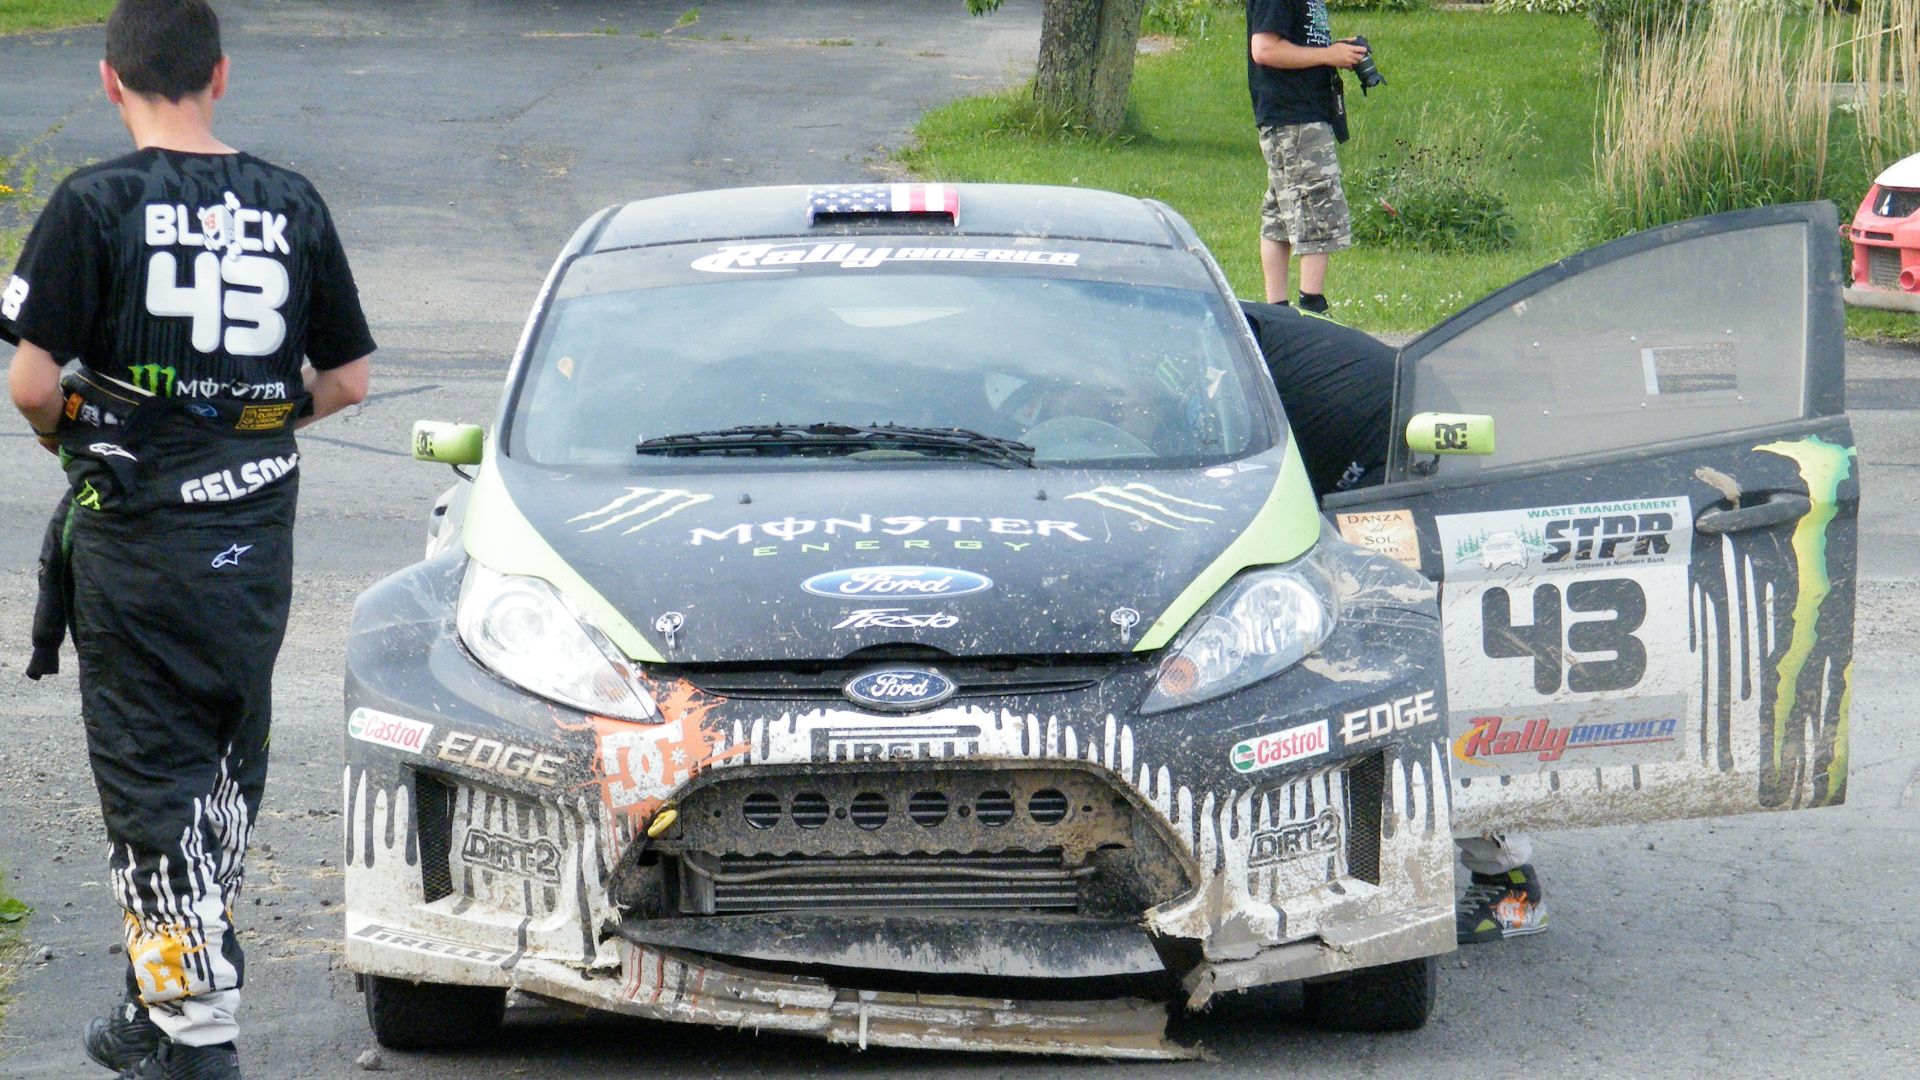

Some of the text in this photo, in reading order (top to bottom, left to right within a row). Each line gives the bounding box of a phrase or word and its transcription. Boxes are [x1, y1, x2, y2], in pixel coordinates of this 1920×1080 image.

[697, 242, 1080, 272] Rally AMERICA
[146, 250, 289, 356] 43
[1347, 514, 1402, 524] DANZA
[1527, 500, 1679, 519] WASTE MANAGEMENT
[752, 540, 1031, 557] ENERGY
[1364, 535, 1397, 546] SOL
[1541, 512, 1674, 563] STPR
[839, 571, 953, 594] Ford
[832, 607, 960, 630] Fiesta
[1482, 578, 1647, 696] 43
[871, 674, 929, 697] Ford
[1256, 690, 1439, 765] Castrol EDGE
[1463, 716, 1677, 762] Rally AMERICA
[364, 715, 567, 786] Castrol EDGE
[353, 924, 513, 963] PIRELLI
